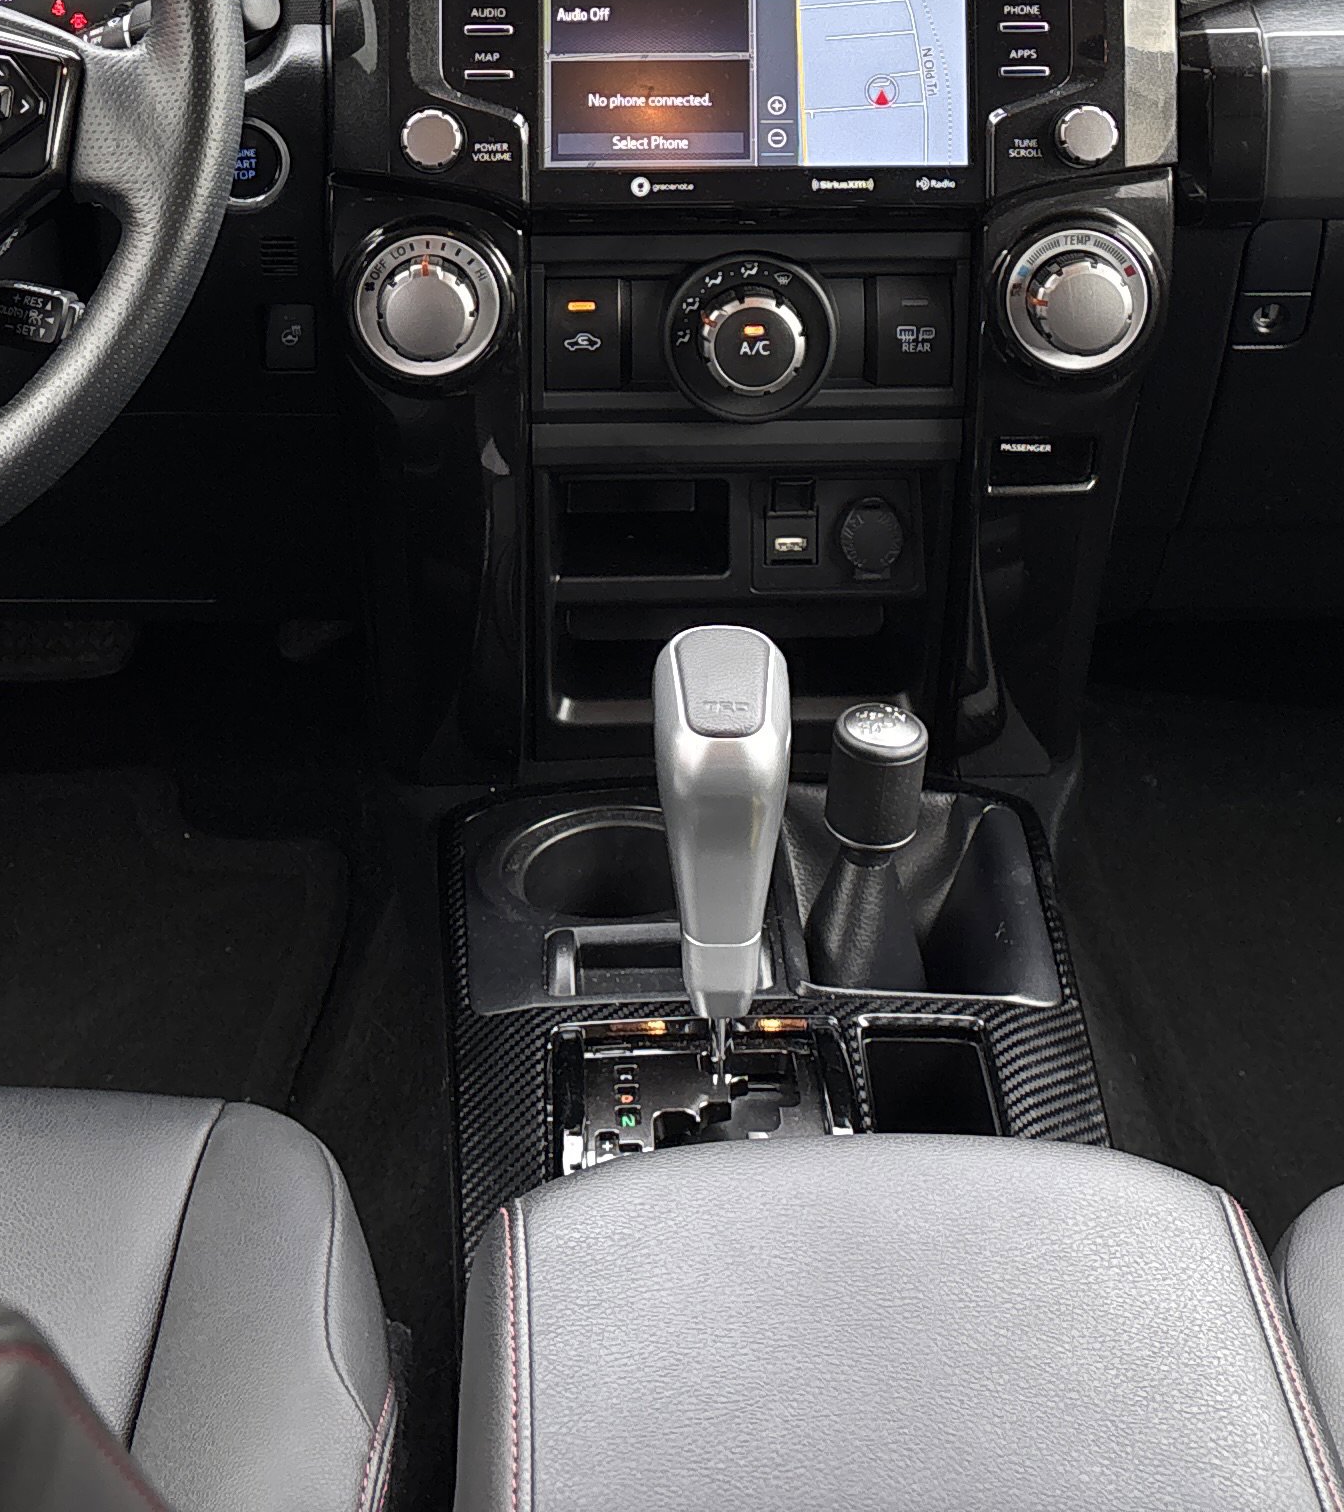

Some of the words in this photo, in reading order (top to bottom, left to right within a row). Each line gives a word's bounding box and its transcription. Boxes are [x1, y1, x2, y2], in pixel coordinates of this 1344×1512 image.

[470, 7, 506, 18] AUDIO
[556, 6, 588, 22] Audio
[590, 6, 611, 22] Off
[1003, 5, 1041, 16] PHONE
[474, 52, 500, 62] MAP
[922, 47, 934, 58] N
[1009, 49, 1038, 60] APPS
[924, 59, 935, 80] Old
[588, 93, 607, 108] No
[609, 92, 646, 109] phone
[649, 92, 713, 108] connected.
[474, 142, 510, 152] POWER
[612, 136, 649, 150] Select
[651, 136, 689, 151] Phone
[1014, 139, 1039, 148] TUNE
[471, 152, 513, 162] VOLUME
[1008, 148, 1043, 158] SCROLL
[236, 159, 257, 168] ART
[233, 170, 256, 180] TOP
[652, 183, 695, 193] gracenote
[930, 179, 956, 189] Radio
[1063, 234, 1091, 246] TEMP
[390, 245, 406, 260] LO
[369, 258, 387, 281] OFF
[474, 268, 488, 282] HI
[23, 295, 44, 308] RES
[16, 324, 37, 337] SET
[739, 341, 771, 356] A/C
[902, 343, 931, 353] REAR
[1000, 443, 1052, 453] PASSENGER
[621, 1113, 636, 1128] N
